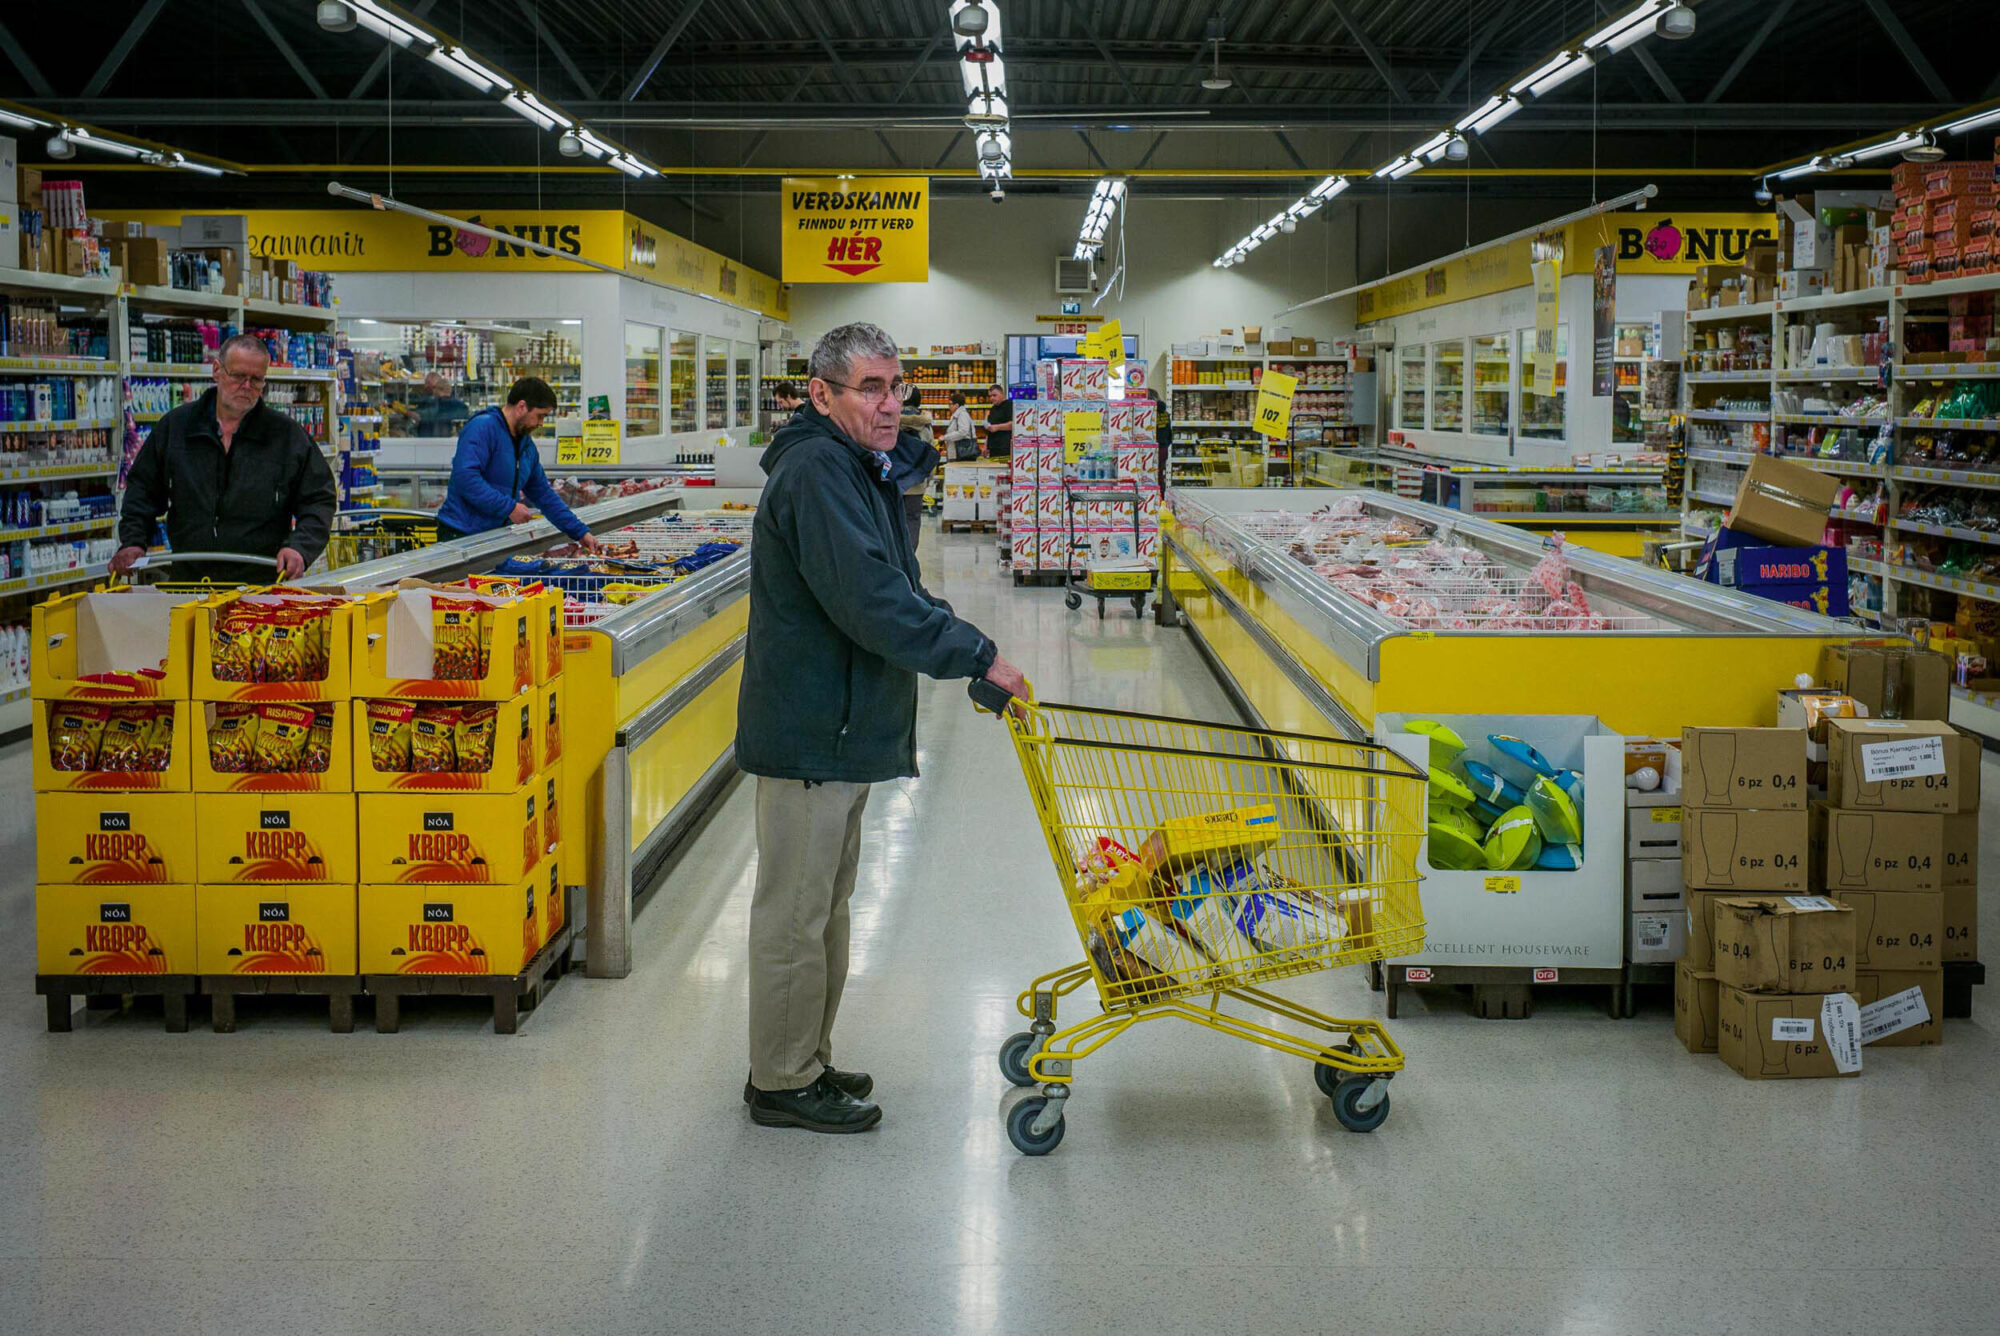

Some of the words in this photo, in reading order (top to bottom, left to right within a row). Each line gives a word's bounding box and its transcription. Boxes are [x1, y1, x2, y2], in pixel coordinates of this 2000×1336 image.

[792, 191, 921, 210] VERÐSKANNI
[850, 218, 878, 230] ÞITT
[882, 218, 914, 230] VERÐ
[827, 231, 882, 262] HÉR
[1262, 408, 1279, 423] 107
[561, 453, 576, 461] 797
[586, 447, 612, 458] 1279
[1760, 564, 1810, 578] HARIBO
[435, 625, 472, 644] KROPP
[265, 707, 305, 721] RISAPOKI
[1738, 776, 1745, 787] 6
[1749, 779, 1763, 790] pz
[1772, 774, 1796, 791] 0,4
[1890, 779, 1898, 787] 6
[1901, 779, 1915, 790] pz
[1925, 775, 1949, 790] 0,4
[104, 817, 126, 826] NÓA
[264, 815, 286, 825] NÓA
[427, 817, 450, 827] NÓA
[85, 832, 147, 861] KROPP
[245, 831, 306, 859] KROPP
[408, 833, 469, 861] KROPP
[1740, 856, 1747, 866] 6
[1750, 858, 1764, 869] pz
[1774, 854, 1798, 870] 0,4
[1874, 858, 1881, 868] 6
[1885, 860, 1898, 870] pz
[1908, 855, 1931, 871] 0,4
[1947, 852, 1969, 867] 0,4
[104, 908, 126, 918] NÓA
[262, 907, 285, 917] NÓA
[427, 908, 450, 918] NÓA
[85, 924, 147, 952] KROPP
[244, 924, 305, 952] KROPP
[408, 924, 469, 952] KROPP
[1946, 926, 1968, 940] 0,4
[1876, 936, 1883, 946] 6
[1886, 937, 1900, 948] pz
[1909, 933, 1933, 949] 0,4
[1424, 943, 1496, 954] XCELLENT
[1501, 944, 1590, 956] HOUSEWARE
[1733, 942, 1750, 960] 0,4
[1790, 960, 1797, 970] 6
[1801, 961, 1813, 972] pz
[1823, 956, 1845, 972] 0,4
[1537, 970, 1553, 979] ora
[1795, 1044, 1802, 1054] 6
[1805, 1046, 1818, 1056] pz
